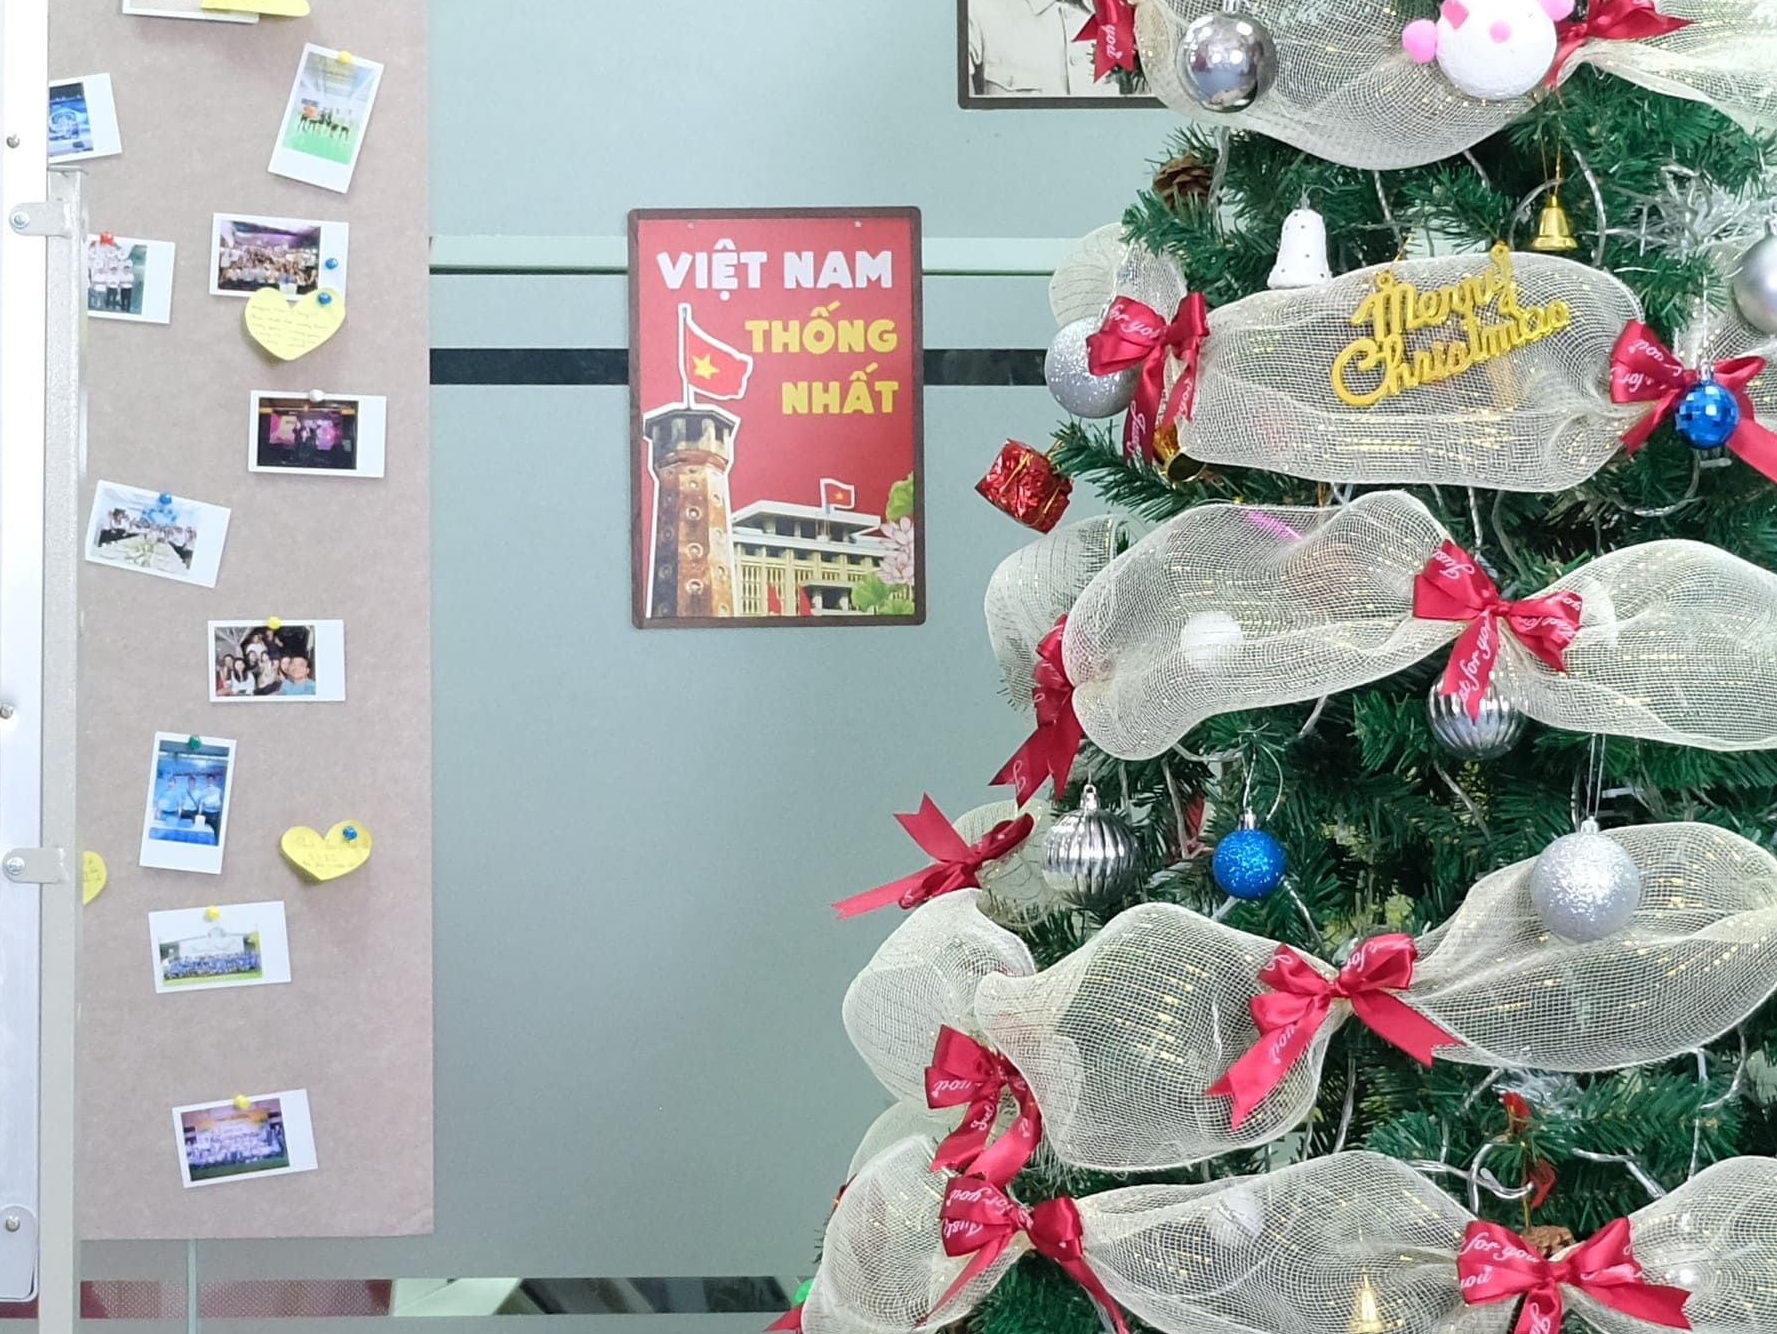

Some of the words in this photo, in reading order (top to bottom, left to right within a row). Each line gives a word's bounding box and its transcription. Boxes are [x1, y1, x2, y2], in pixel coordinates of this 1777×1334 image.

[1103, 24, 1123, 59] you
[657, 238, 767, 301] VIỆT
[783, 250, 893, 288] NAM
[745, 301, 897, 353] THỐNG
[782, 363, 899, 415] NHẤT
[948, 1187, 991, 1209] you
[1464, 1237, 1498, 1262] for
